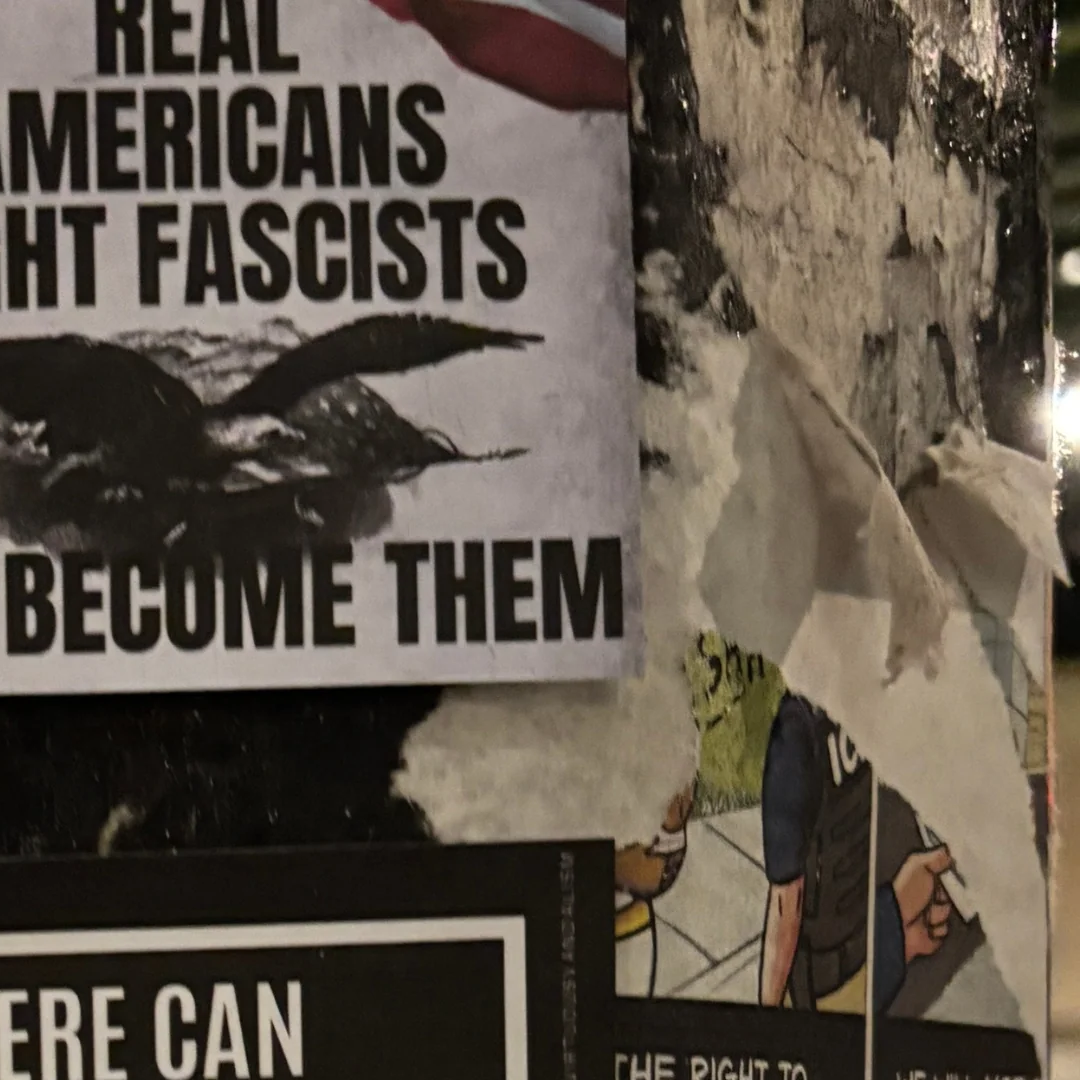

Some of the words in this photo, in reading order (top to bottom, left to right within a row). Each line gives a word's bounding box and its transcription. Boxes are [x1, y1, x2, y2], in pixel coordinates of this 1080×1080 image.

[95, 0, 300, 76] REAL
[137, 197, 528, 306] FASCISTS
[5, 542, 356, 656] BECOME
[383, 535, 626, 645] THEM
